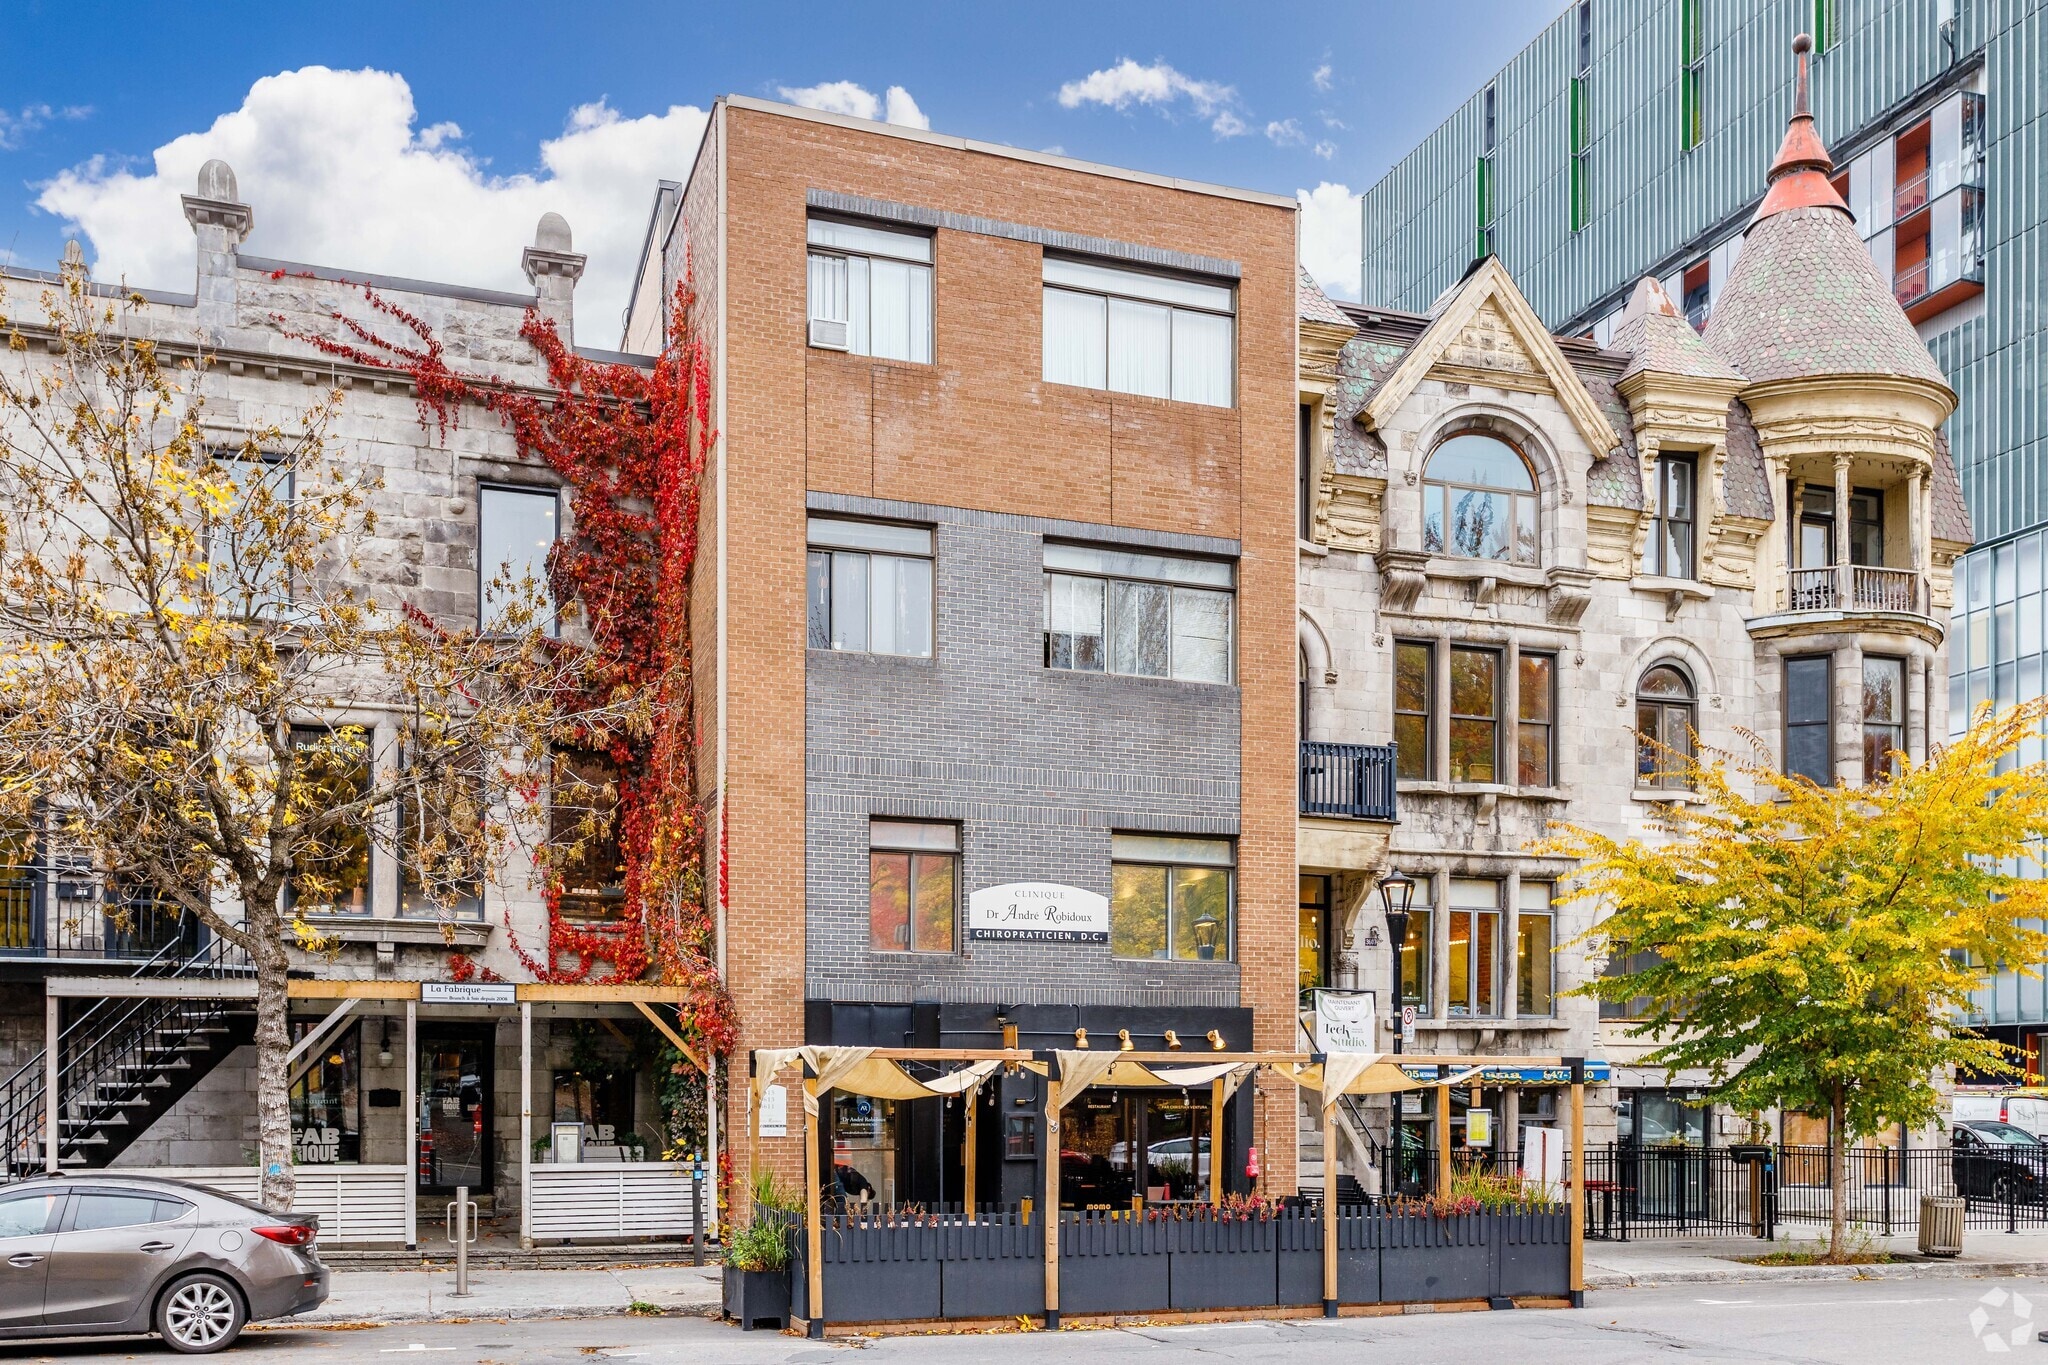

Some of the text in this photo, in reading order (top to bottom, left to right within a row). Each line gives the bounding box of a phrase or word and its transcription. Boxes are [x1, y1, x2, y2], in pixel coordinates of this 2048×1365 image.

[1014, 890, 1065, 900] CLINIQUE
[986, 904, 1092, 924] Dr André Robidoux
[976, 930, 1103, 941] CHIROPRATICIEN, D.C.
[430, 984, 481, 996] La Fabrique
[1330, 1036, 1367, 1047] Studio.
[292, 1128, 340, 1145] FAB
[583, 1124, 616, 1141] AB
